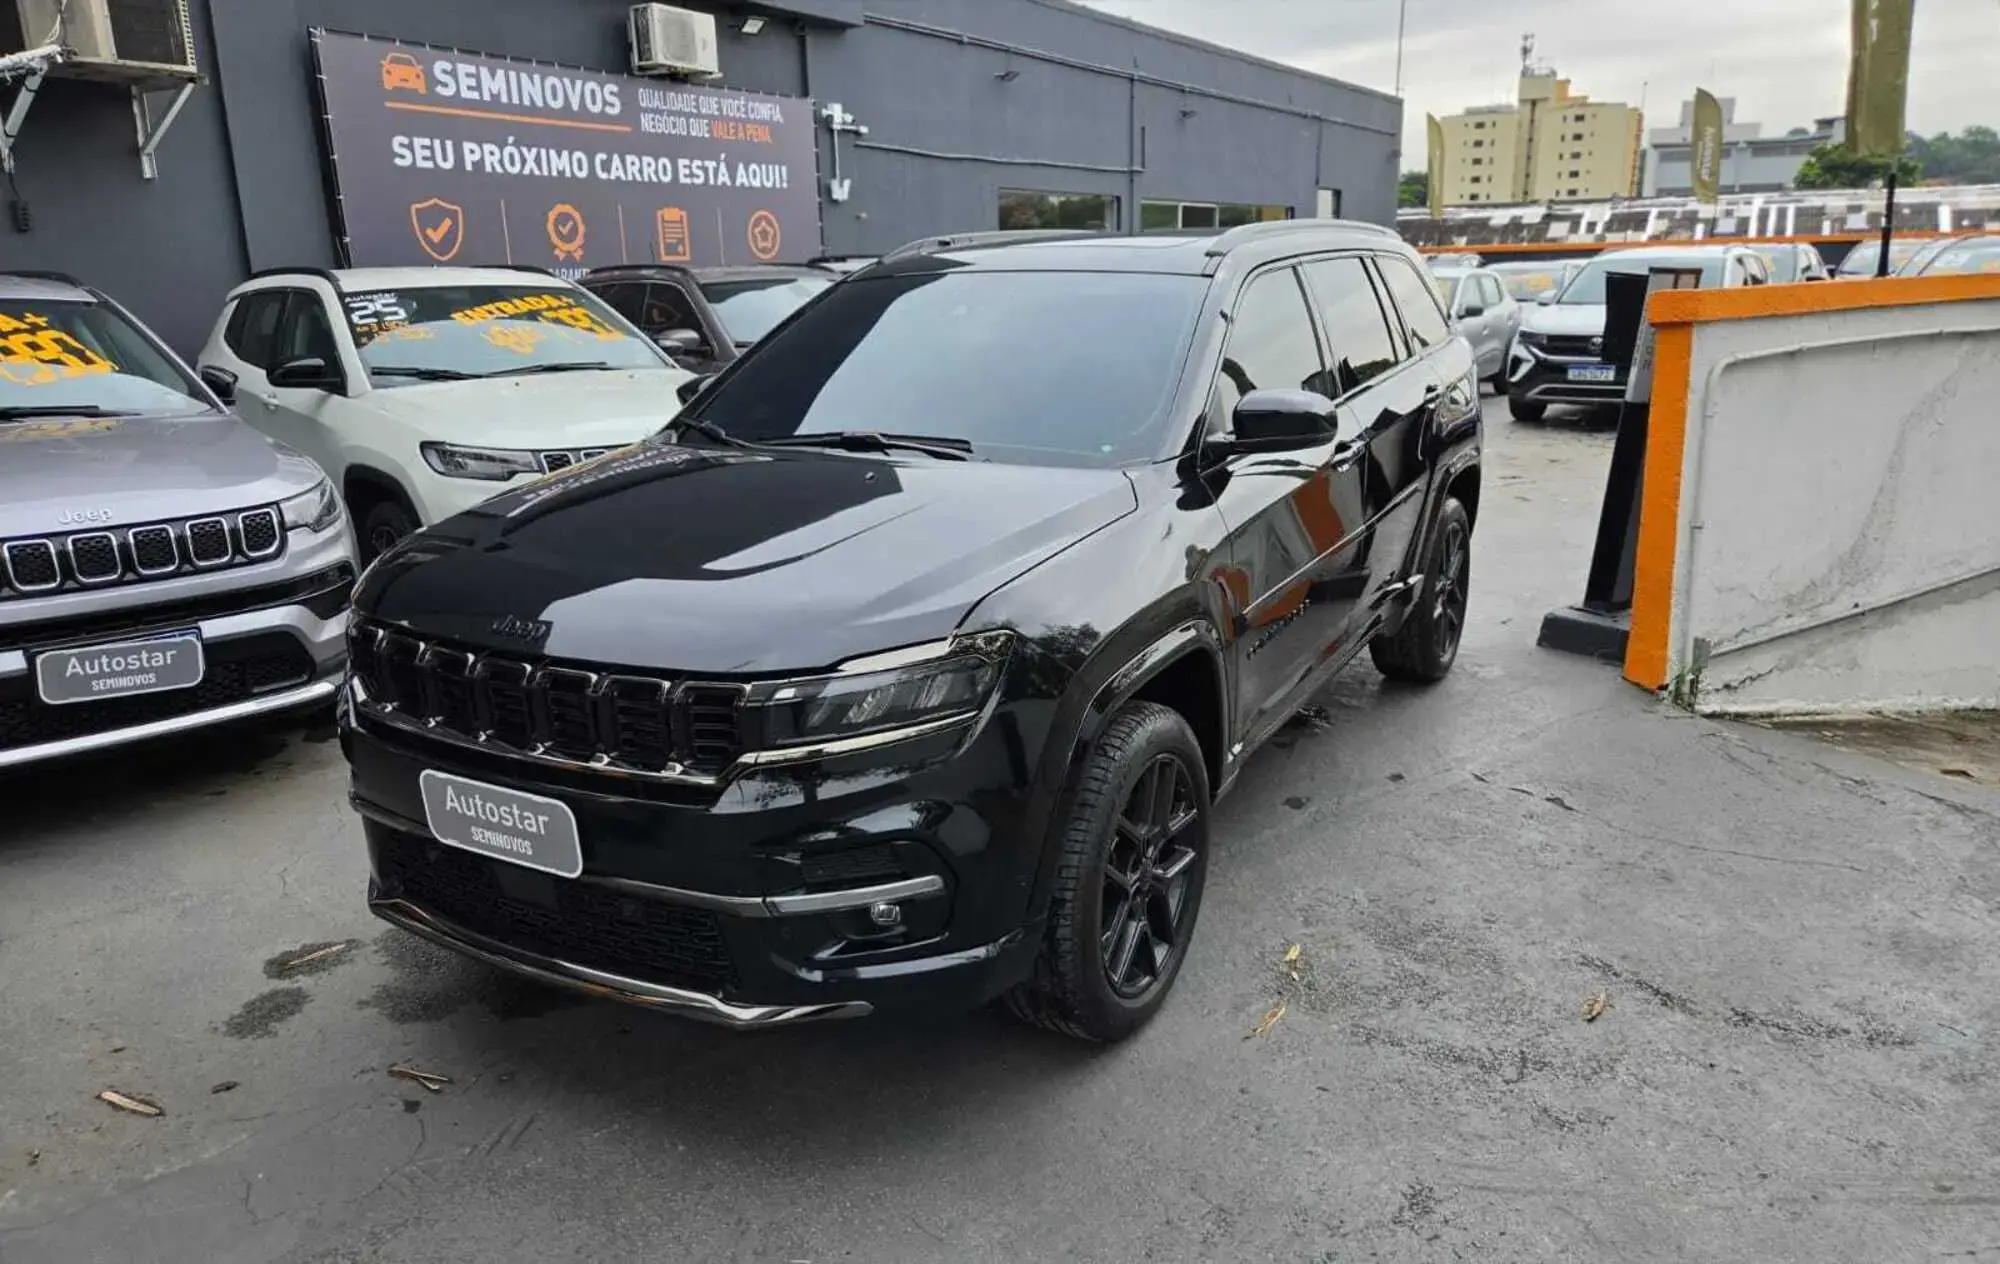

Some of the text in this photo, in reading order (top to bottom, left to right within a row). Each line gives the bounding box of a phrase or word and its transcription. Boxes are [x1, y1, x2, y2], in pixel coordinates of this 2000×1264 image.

[433, 60, 621, 116] SEMINOVOS
[638, 88, 697, 113] QUALIDADE
[699, 95, 720, 116] QUE
[721, 96, 745, 119] VOCÊ
[640, 111, 687, 136] NEGÓCIO
[689, 118, 710, 138] QUE
[711, 120, 736, 139] VALE
[737, 122, 745, 140] A
[392, 135, 788, 189] SEU PRÓXIMO CARRO ESTÁ AQUI!
[349, 299, 408, 324] 25
[59, 508, 112, 525] Jeep
[65, 650, 177, 678] Autostar
[91, 673, 156, 691] SEMINOVOS
[446, 785, 549, 835] Autostar
[470, 826, 533, 855] SEMINOVOS
